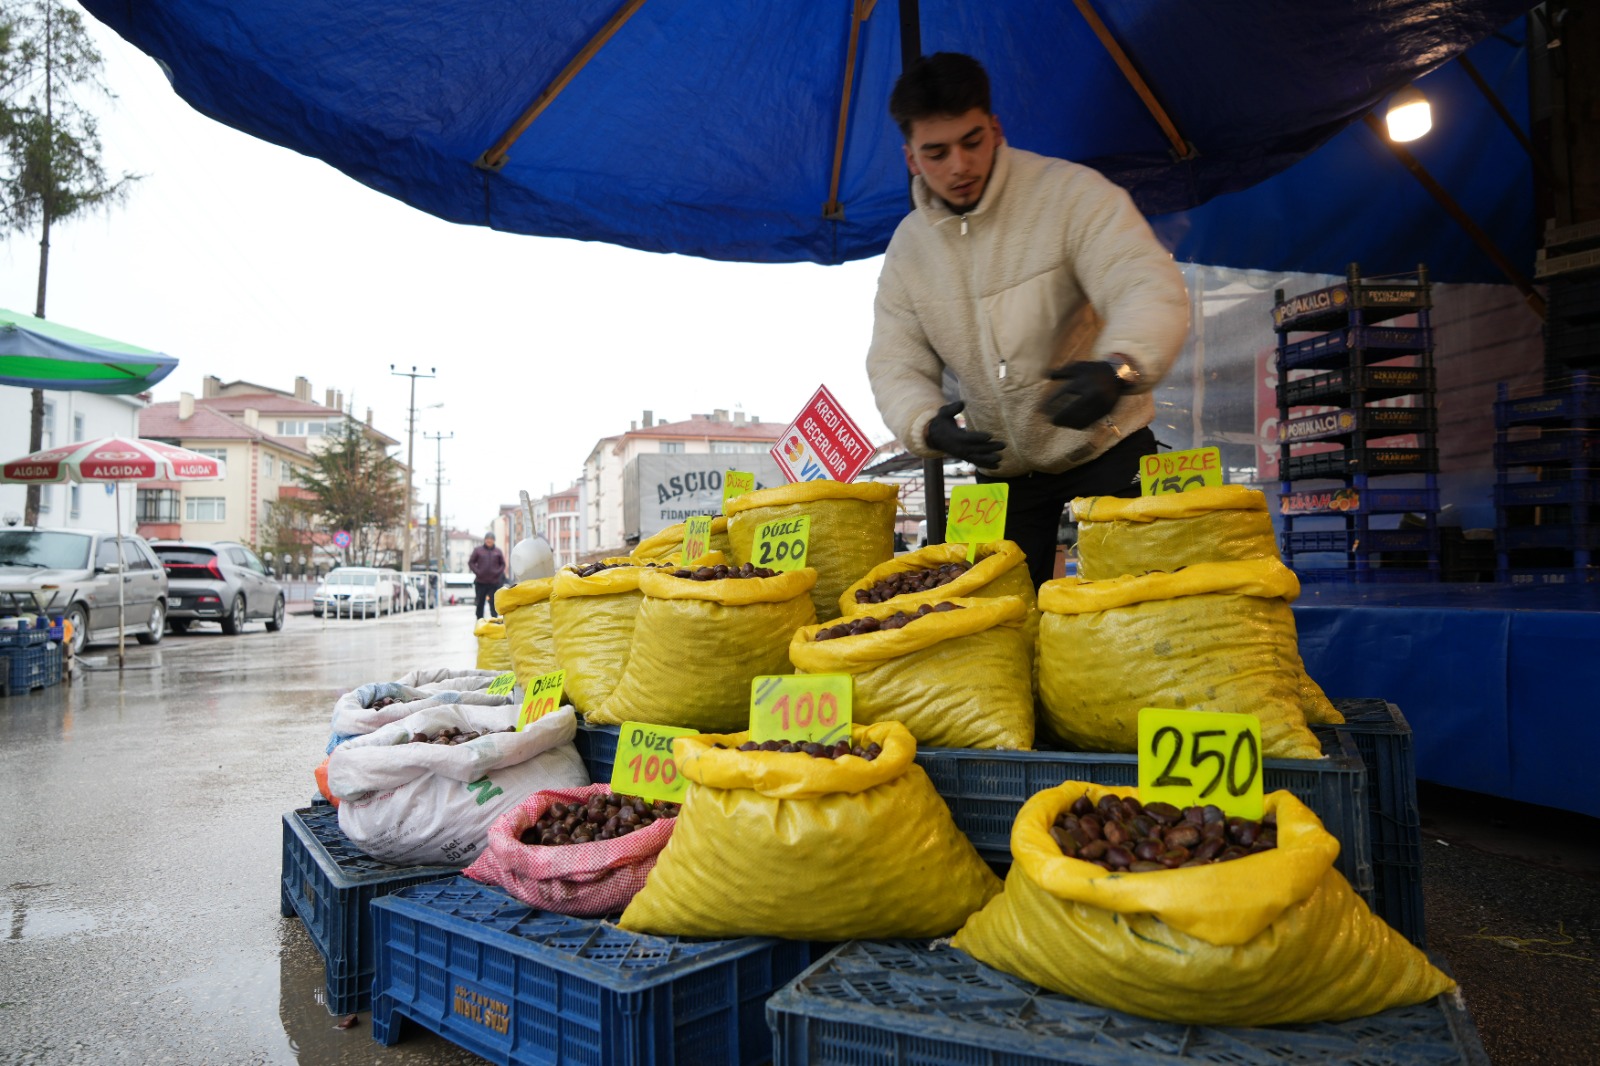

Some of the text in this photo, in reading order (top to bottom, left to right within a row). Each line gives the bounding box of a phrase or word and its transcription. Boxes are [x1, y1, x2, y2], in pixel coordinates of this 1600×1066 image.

[814, 398, 863, 460] KREDİ KARTI
[803, 416, 847, 477] GEÇERLİDİR
[13, 467, 49, 476] ALGIDA
[93, 466, 143, 476] ALGIDA
[180, 465, 210, 475] ALGIDA
[801, 455, 828, 482] VI
[1145, 452, 1217, 476] DÜZCE
[956, 497, 1005, 526] 250
[761, 518, 805, 539] DÜZCE
[759, 539, 805, 564] 200
[532, 673, 563, 696] DÜZCE
[525, 697, 554, 725] 100
[771, 691, 838, 731] 100
[631, 728, 674, 752] DÜZC
[628, 753, 677, 785] 100
[1151, 726, 1259, 799] 250
[440, 838, 463, 854] Net:
[446, 842, 477, 862] 50 kg
